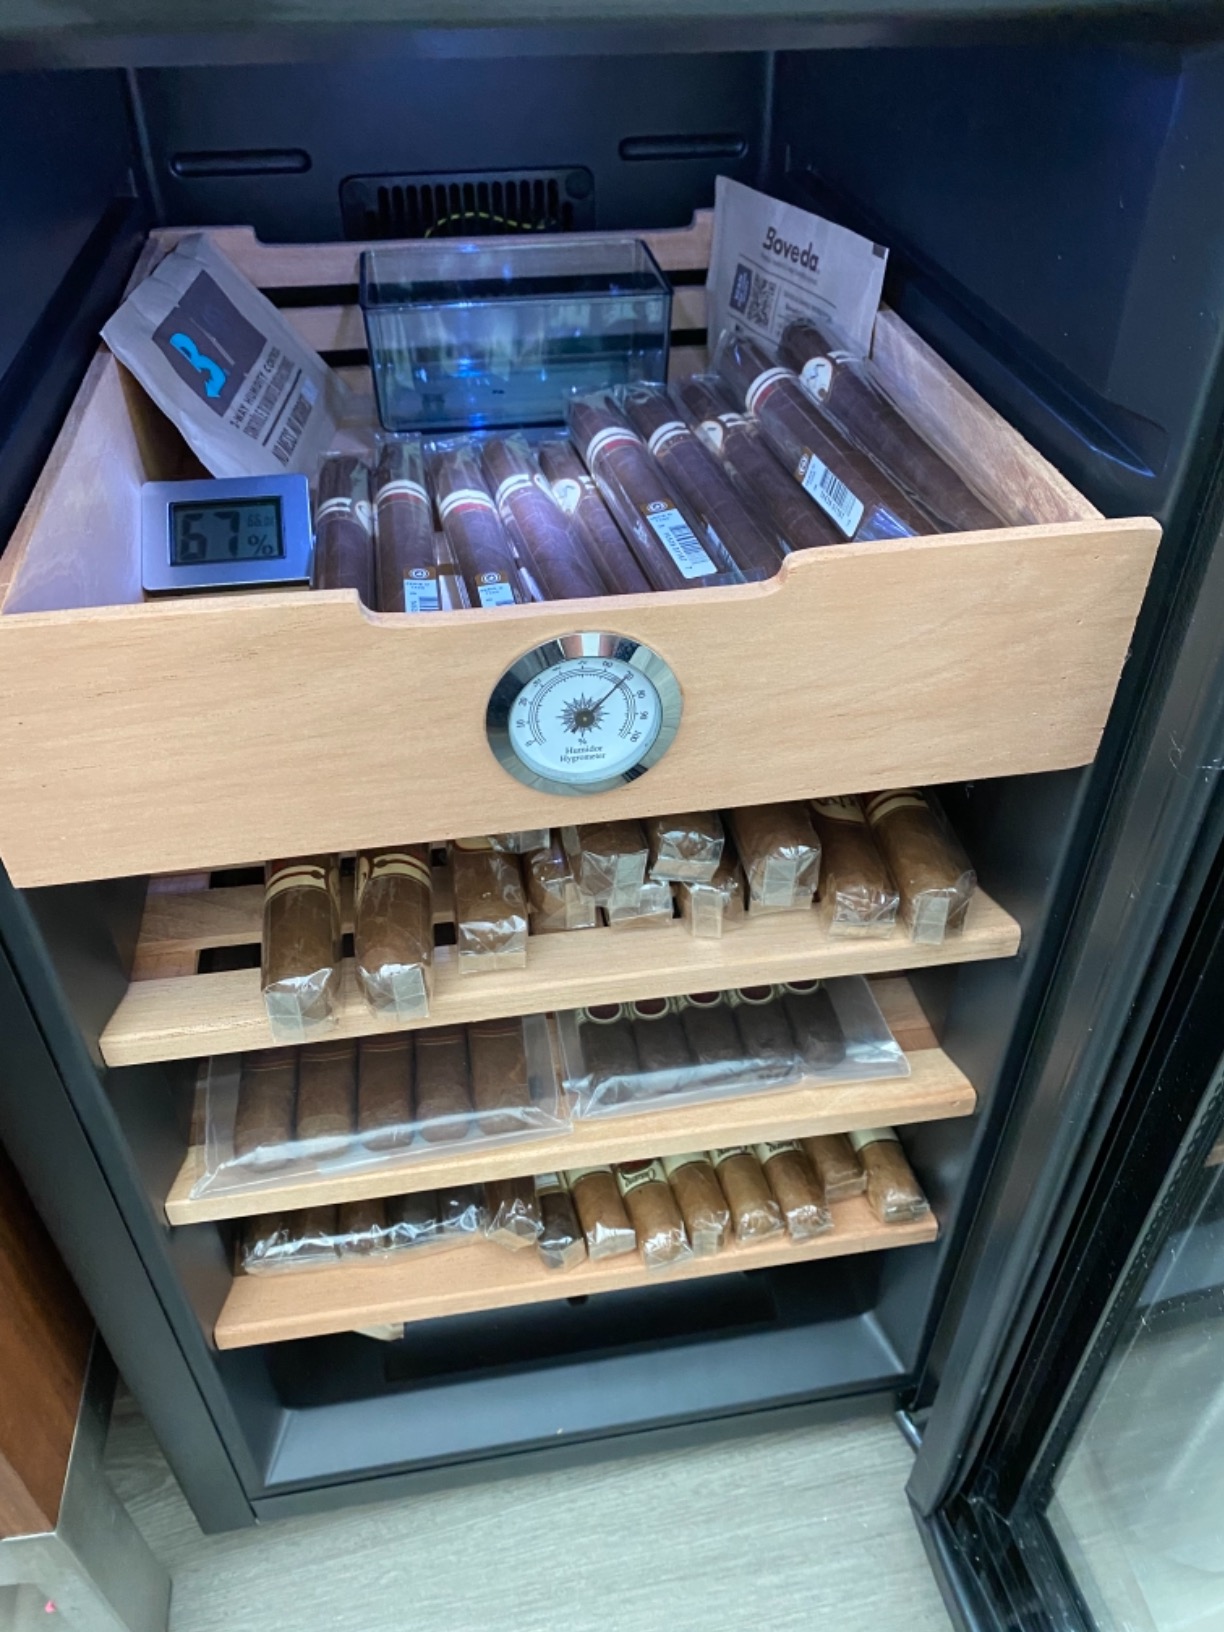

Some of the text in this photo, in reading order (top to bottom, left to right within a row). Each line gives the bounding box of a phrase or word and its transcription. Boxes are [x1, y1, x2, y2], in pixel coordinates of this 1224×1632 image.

[762, 227, 819, 271] Boveda
[180, 511, 274, 560] 67 %
[560, 753, 606, 764] Hygrometer
[565, 746, 603, 756] Humidor
